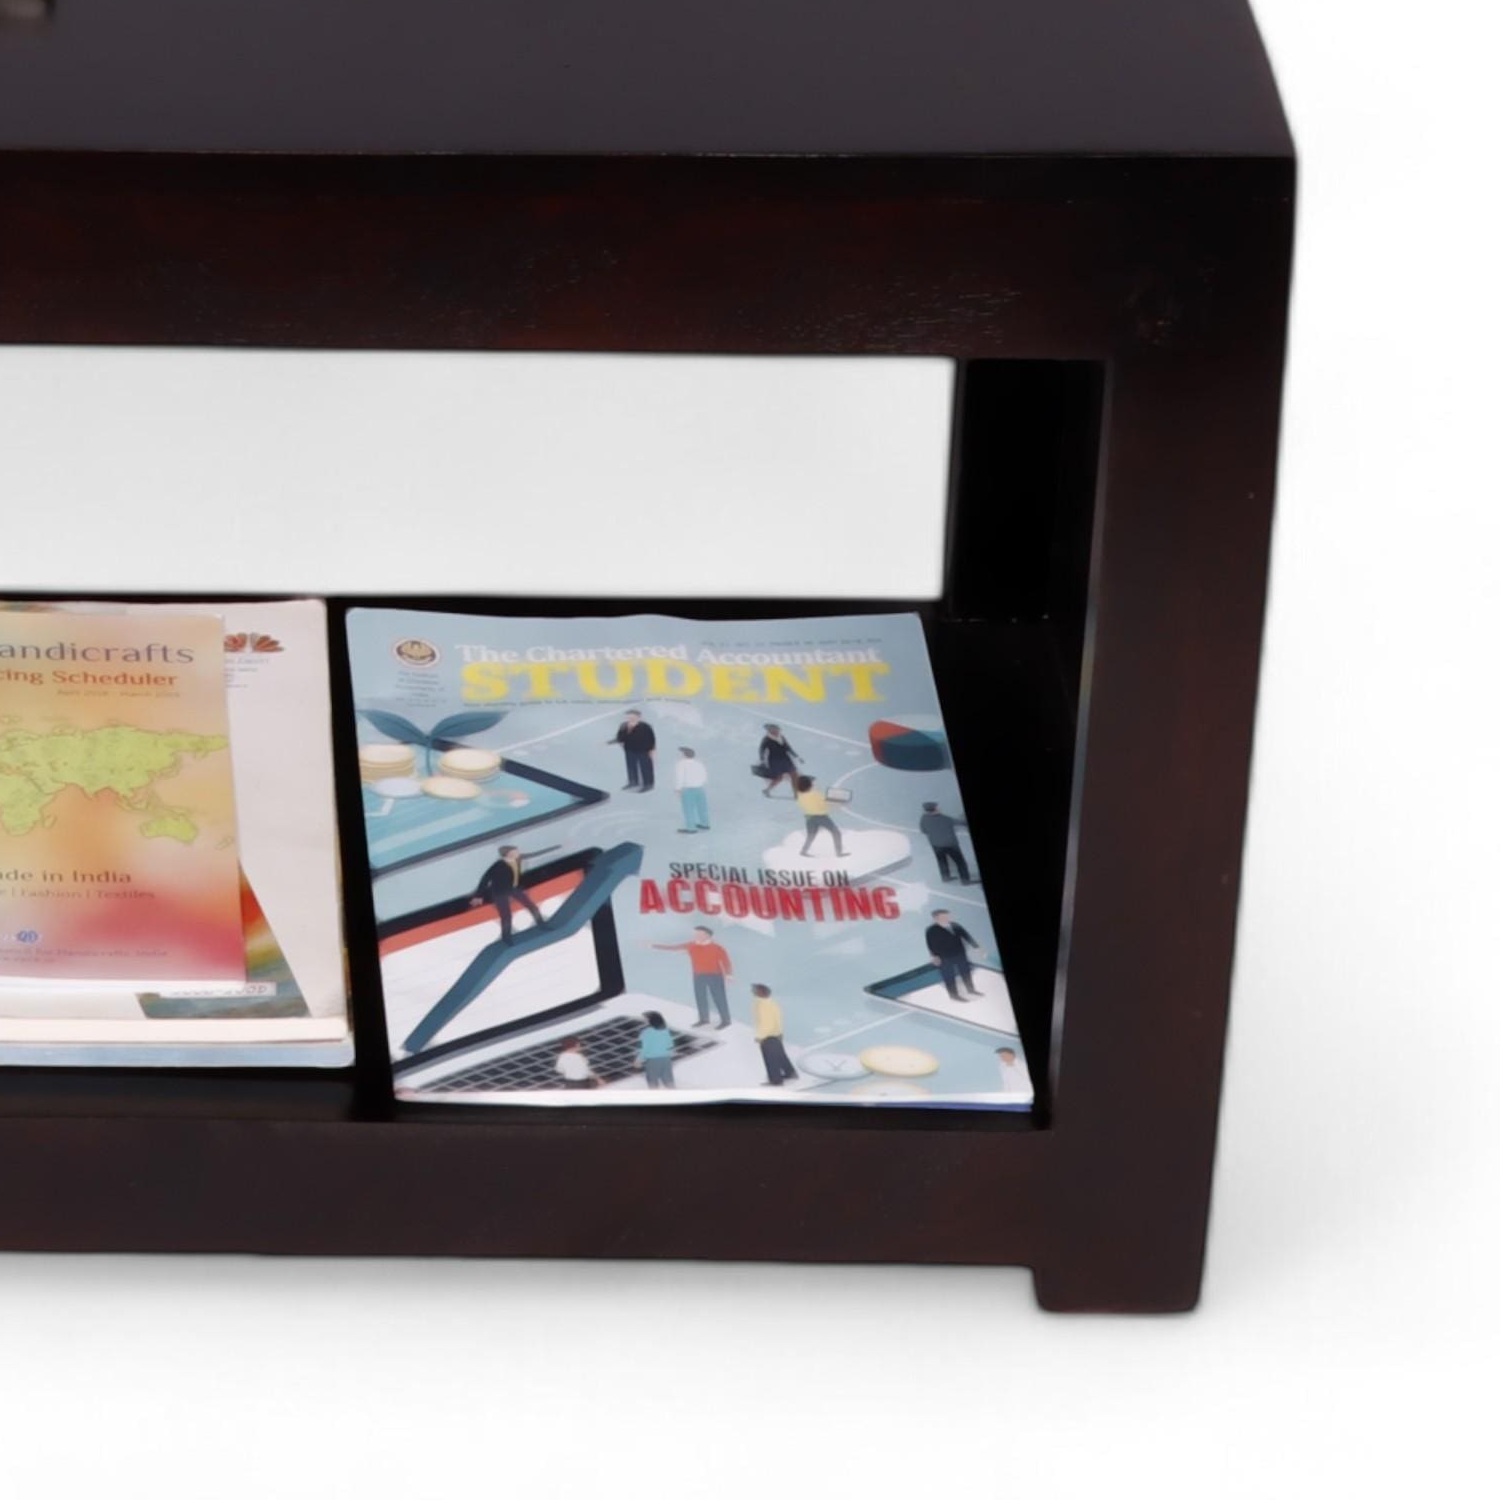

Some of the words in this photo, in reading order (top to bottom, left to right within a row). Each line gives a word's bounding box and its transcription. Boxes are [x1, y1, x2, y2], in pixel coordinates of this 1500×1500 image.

[455, 643, 518, 662] The
[524, 643, 688, 663] Chartered
[697, 646, 884, 664] Accountant
[52, 669, 179, 687] Scheduler
[461, 657, 891, 703] STUDENT
[42, 869, 65, 883] in
[72, 869, 133, 884] India
[669, 861, 752, 885] SPECIAL
[758, 868, 819, 887] ISSUE
[823, 869, 852, 887] ON
[20, 886, 84, 900] Fashion
[95, 888, 156, 901] Textiles
[640, 877, 901, 922] ACCOUNTING
